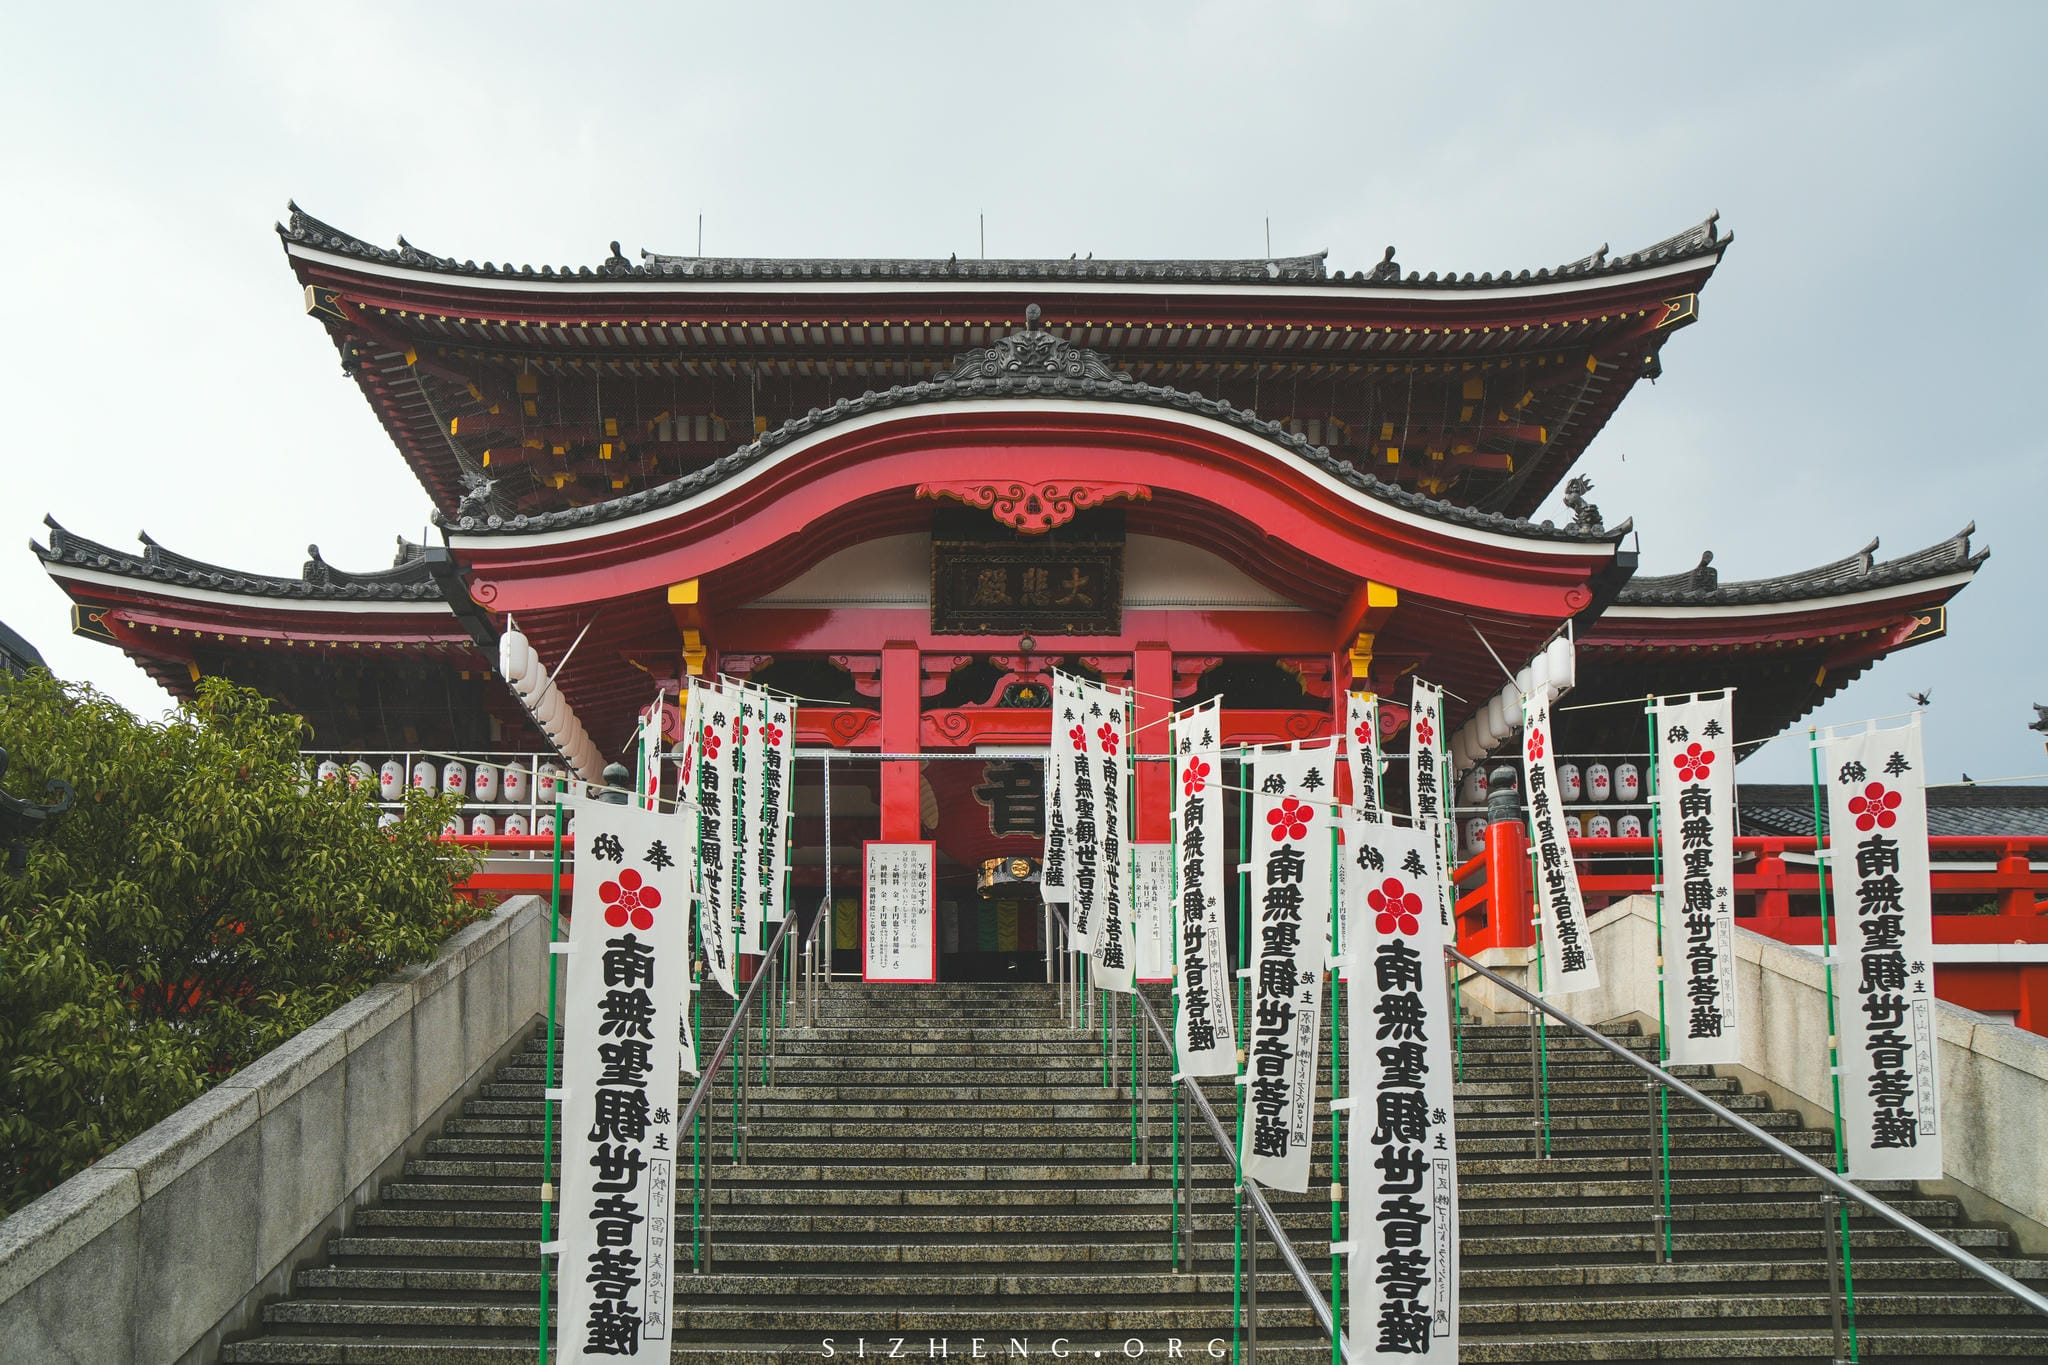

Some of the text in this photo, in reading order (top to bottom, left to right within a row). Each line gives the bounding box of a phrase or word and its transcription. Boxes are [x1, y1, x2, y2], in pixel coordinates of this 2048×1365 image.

[713, 711, 727, 728] 納
[1090, 702, 1122, 725] 奉納
[1101, 757, 1125, 970] 南無聖観世音菩薩
[917, 862, 927, 915] 写経のすすめ
